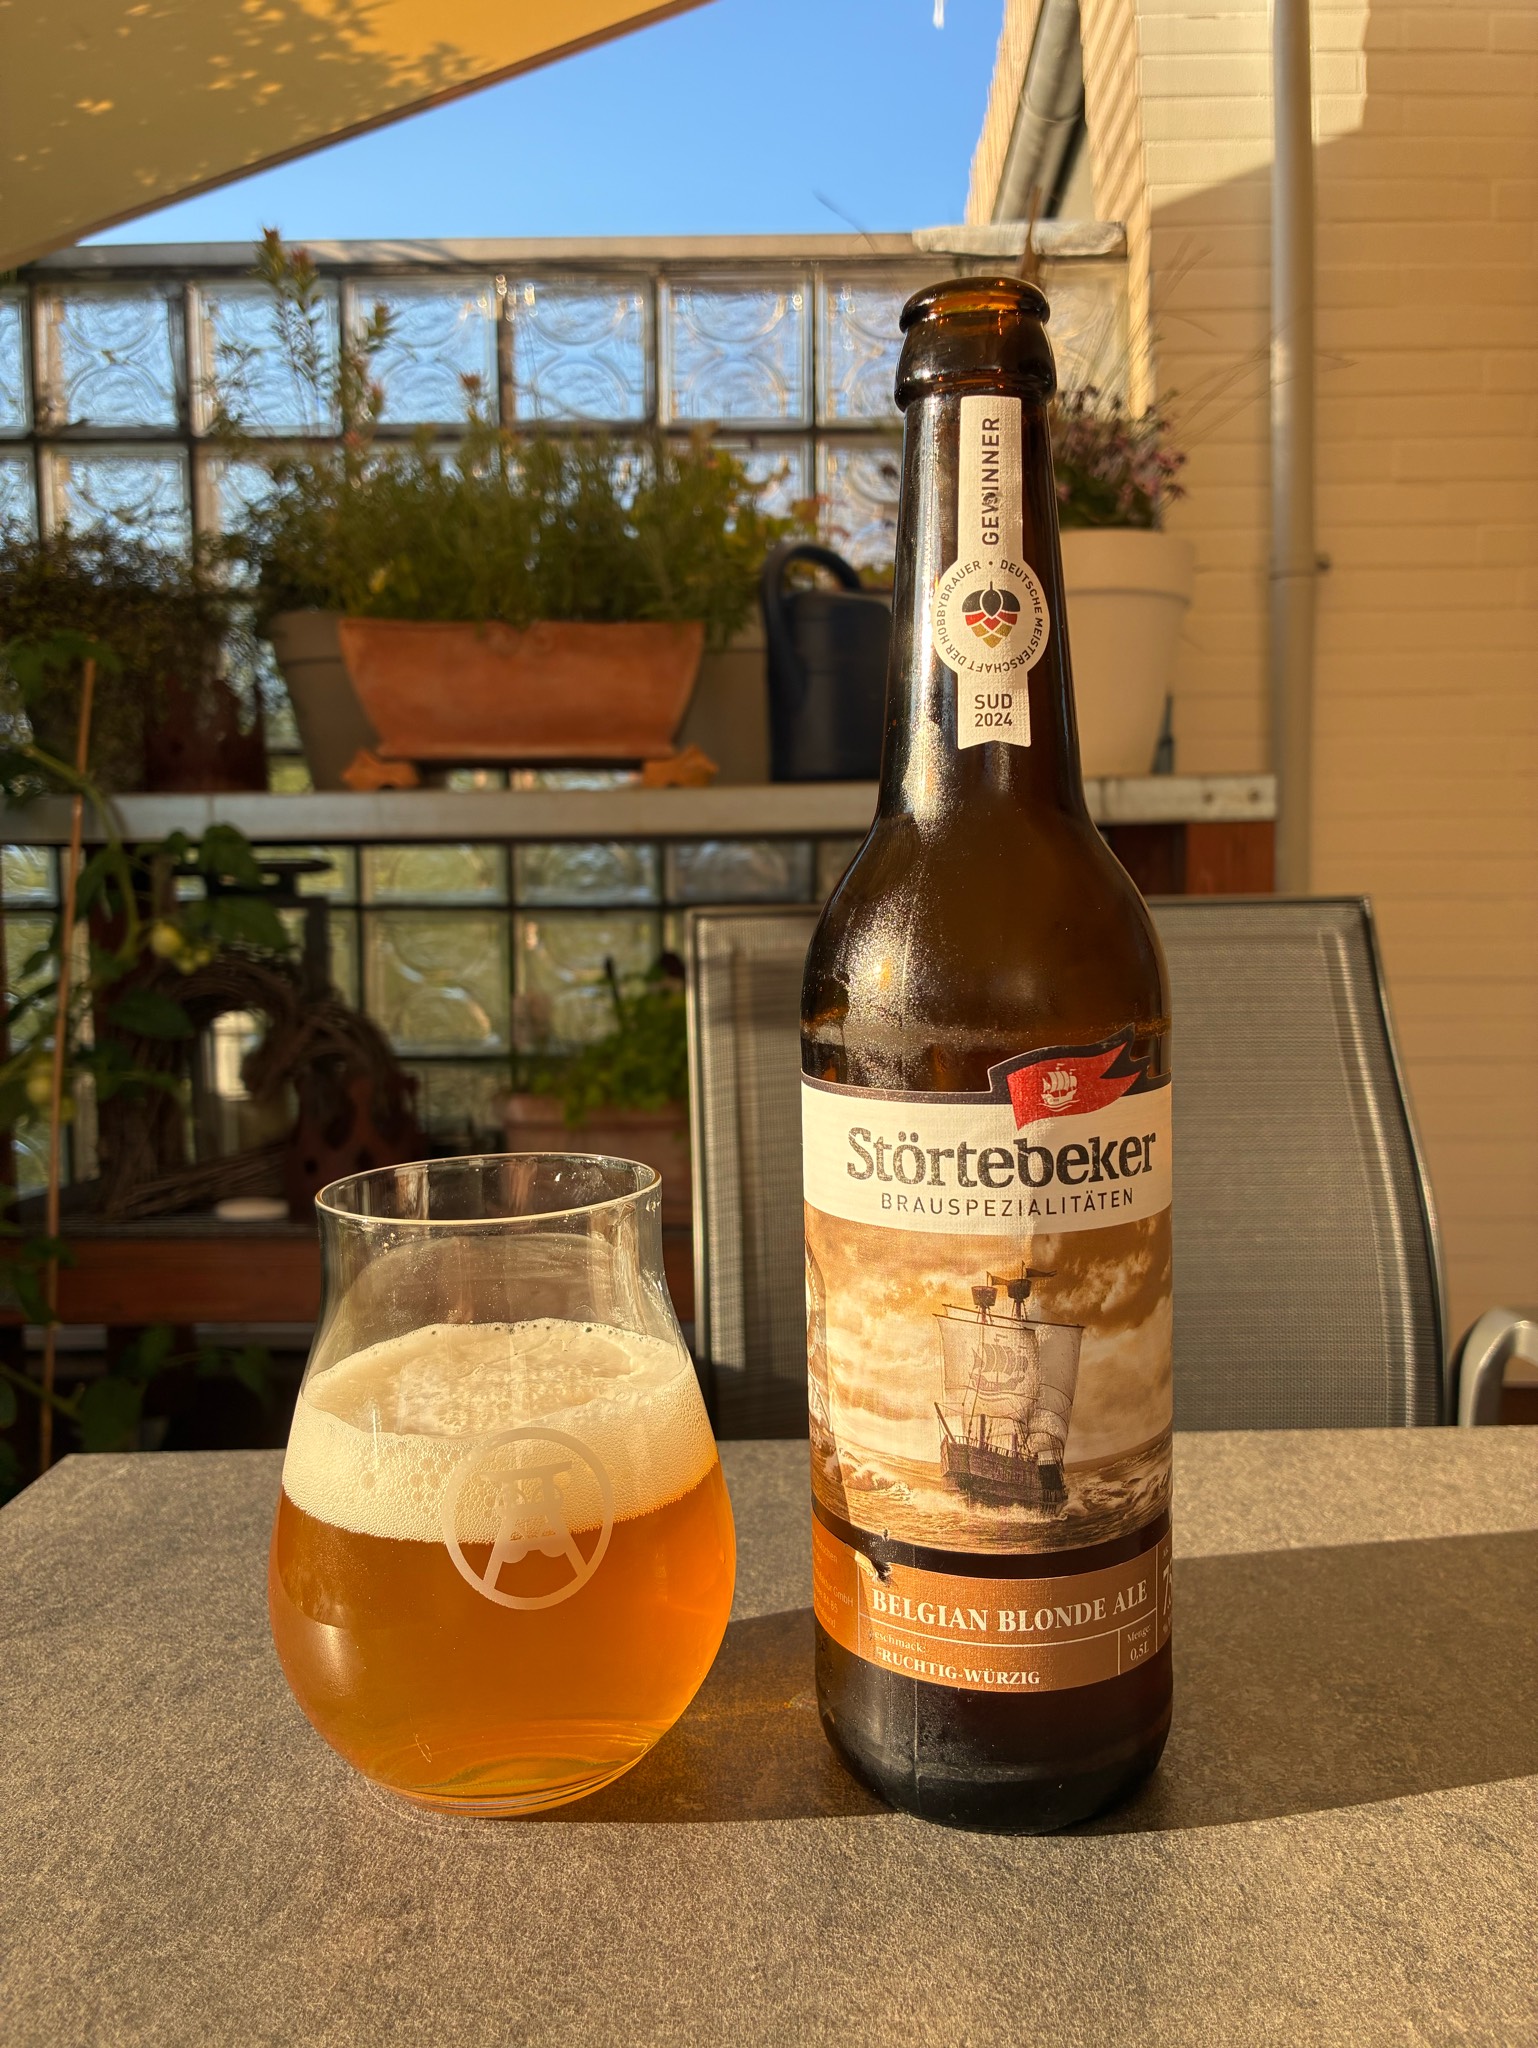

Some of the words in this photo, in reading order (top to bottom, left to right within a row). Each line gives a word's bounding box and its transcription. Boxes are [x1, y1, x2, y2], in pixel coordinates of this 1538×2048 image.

[1000, 559, 1043, 614] DEUTSCHE
[937, 560, 981, 644] HOBBYBRAUER
[945, 643, 968, 666] DER
[967, 617, 1044, 673] MEISTERSCHAFT
[974, 693, 1013, 710] SUD
[974, 712, 1013, 728] 2024
[846, 1127, 1156, 1189] Störtebeker
[881, 1187, 1134, 1217] BRAUSPEZIALITÄTEN
[833, 1586, 854, 1607] GmbH
[871, 1587, 988, 1632] BELGIAN
[997, 1600, 1106, 1632] BLONDE
[1112, 1579, 1148, 1615] ALE
[870, 1630, 926, 1653] eschmack:
[1127, 1624, 1151, 1643] Menge:
[1130, 1641, 1150, 1661] 0,5L
[875, 1646, 1041, 1685] FRUCHTIG-WÜRZIG
